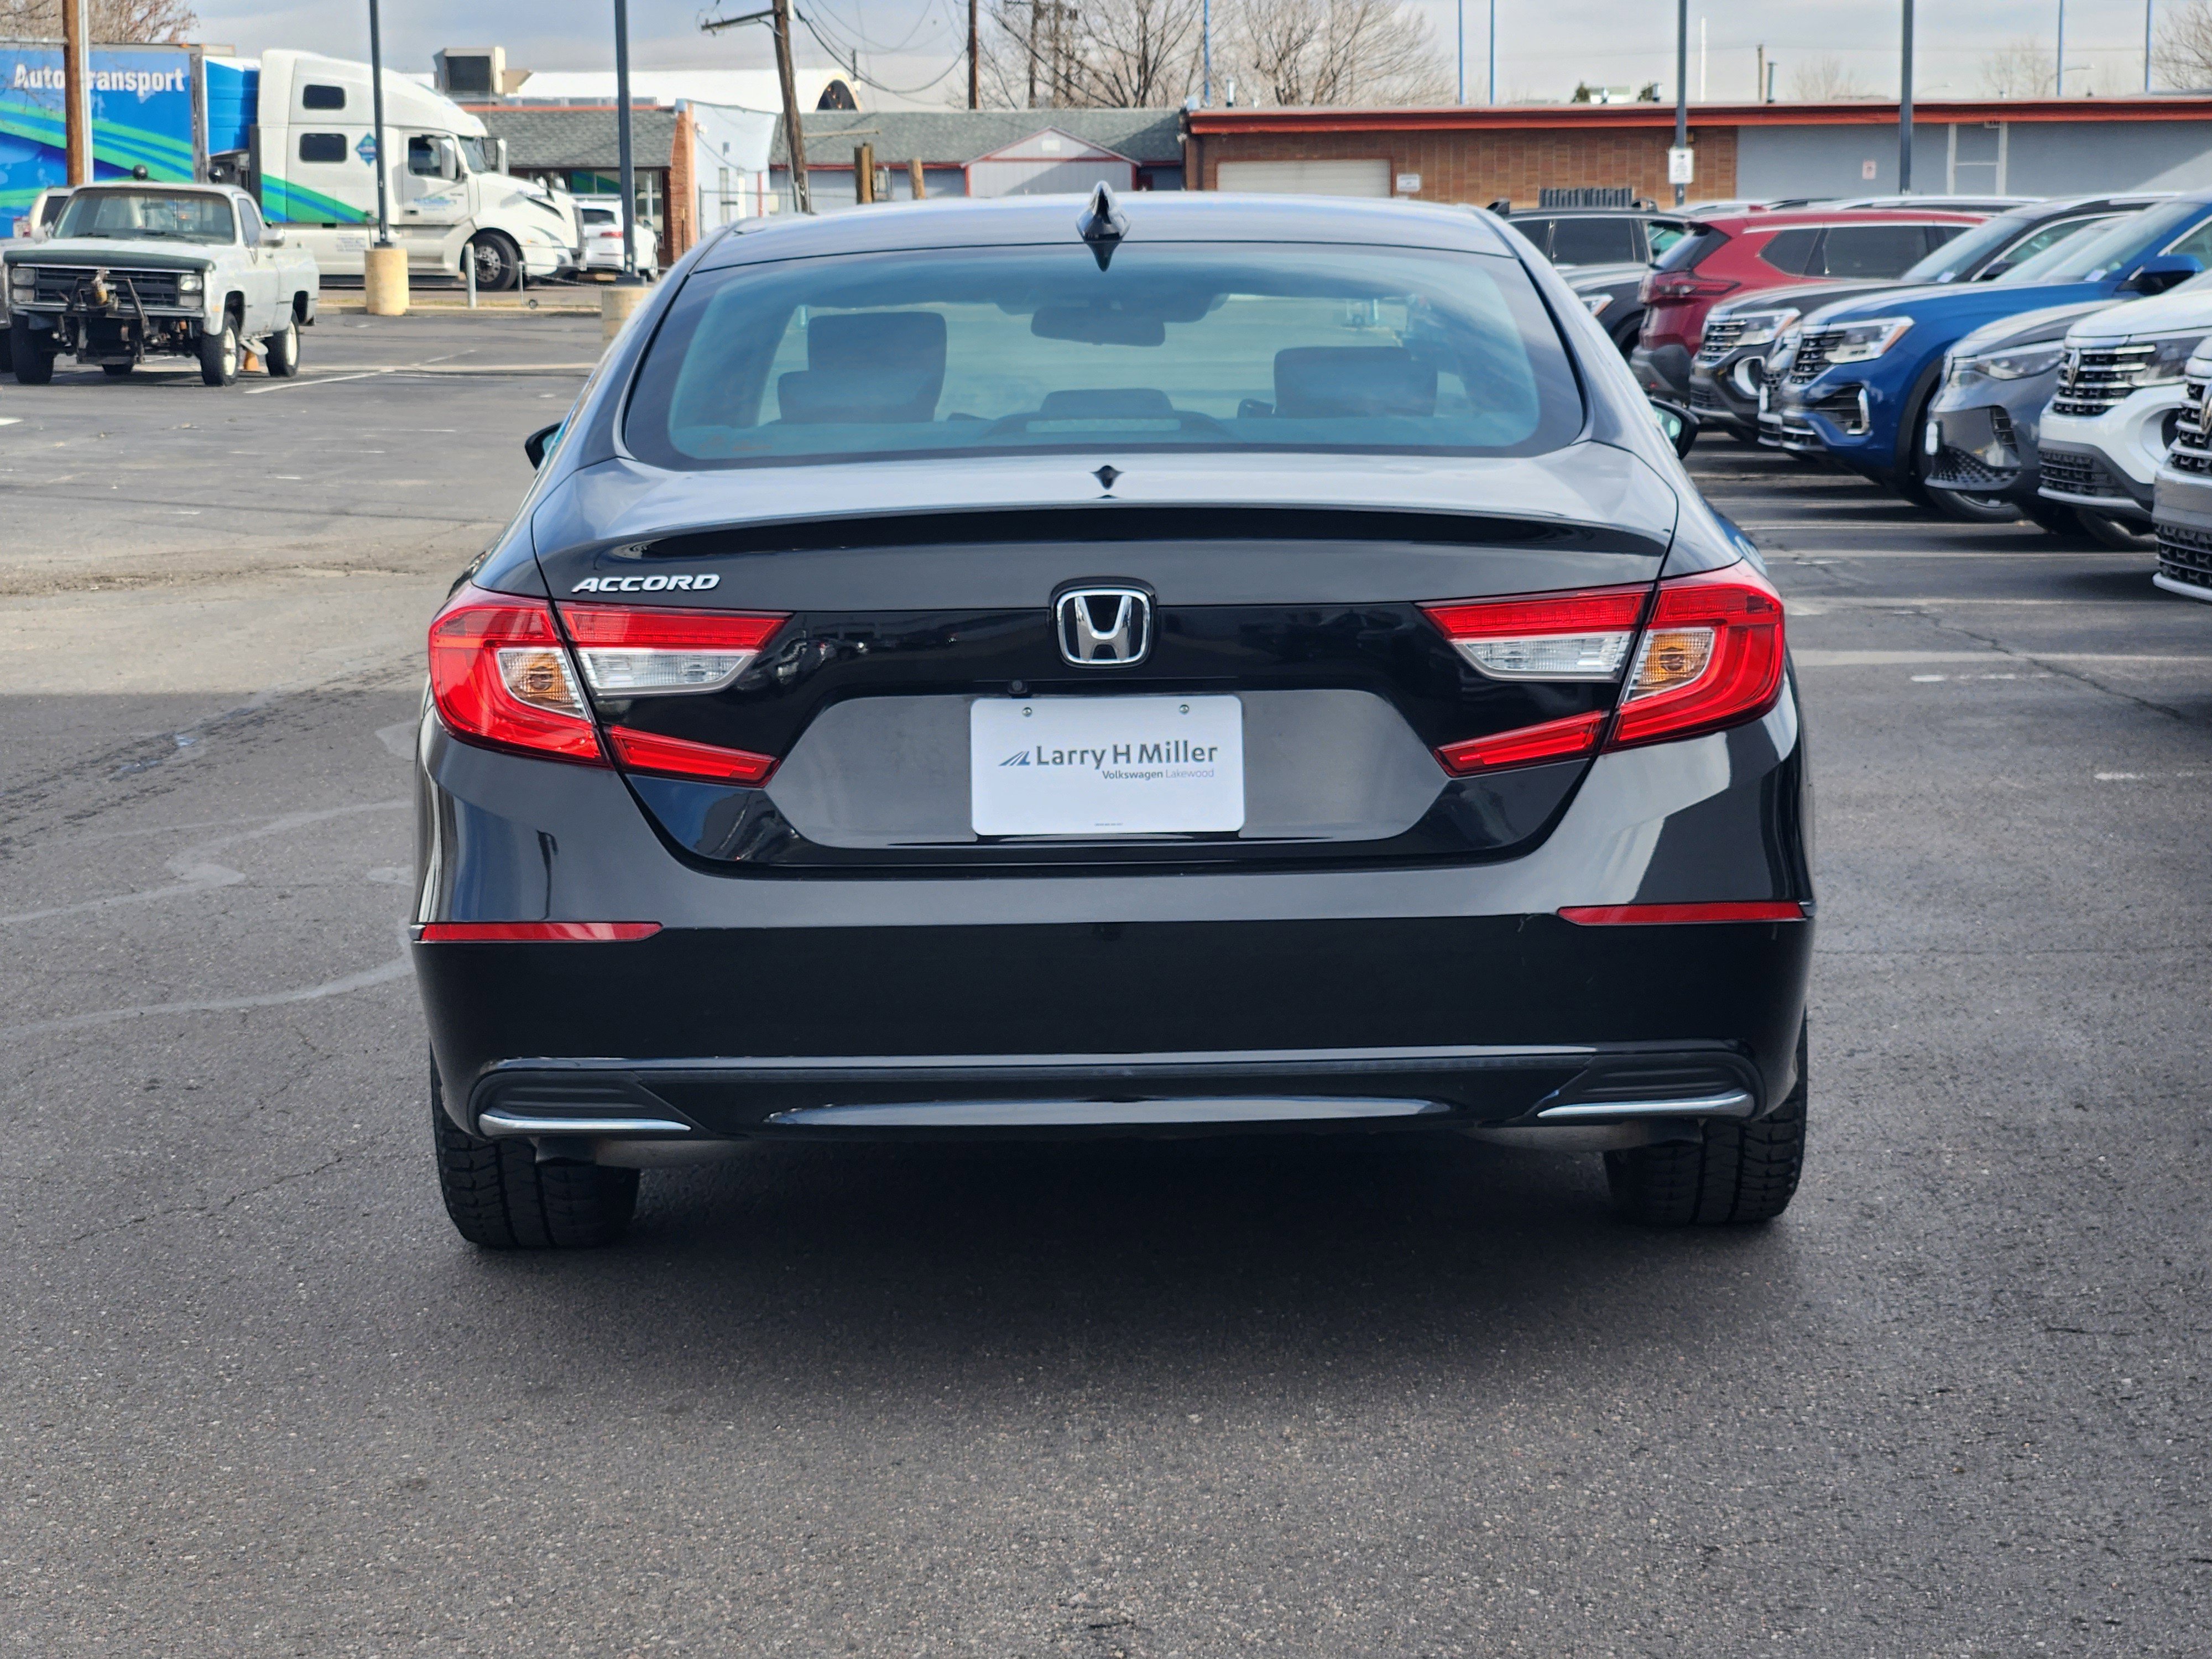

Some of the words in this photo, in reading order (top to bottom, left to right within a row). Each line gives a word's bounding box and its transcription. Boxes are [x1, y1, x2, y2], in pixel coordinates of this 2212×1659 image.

[14, 64, 65, 89] Auto
[87, 67, 185, 97] ransport
[571, 574, 720, 592] ACCORD
[1036, 745, 1106, 770] Larry
[1113, 744, 1131, 764] H
[1138, 740, 1218, 764] Miller
[1102, 770, 1164, 780] Volkswagen
[1166, 768, 1214, 778] Lakewood
